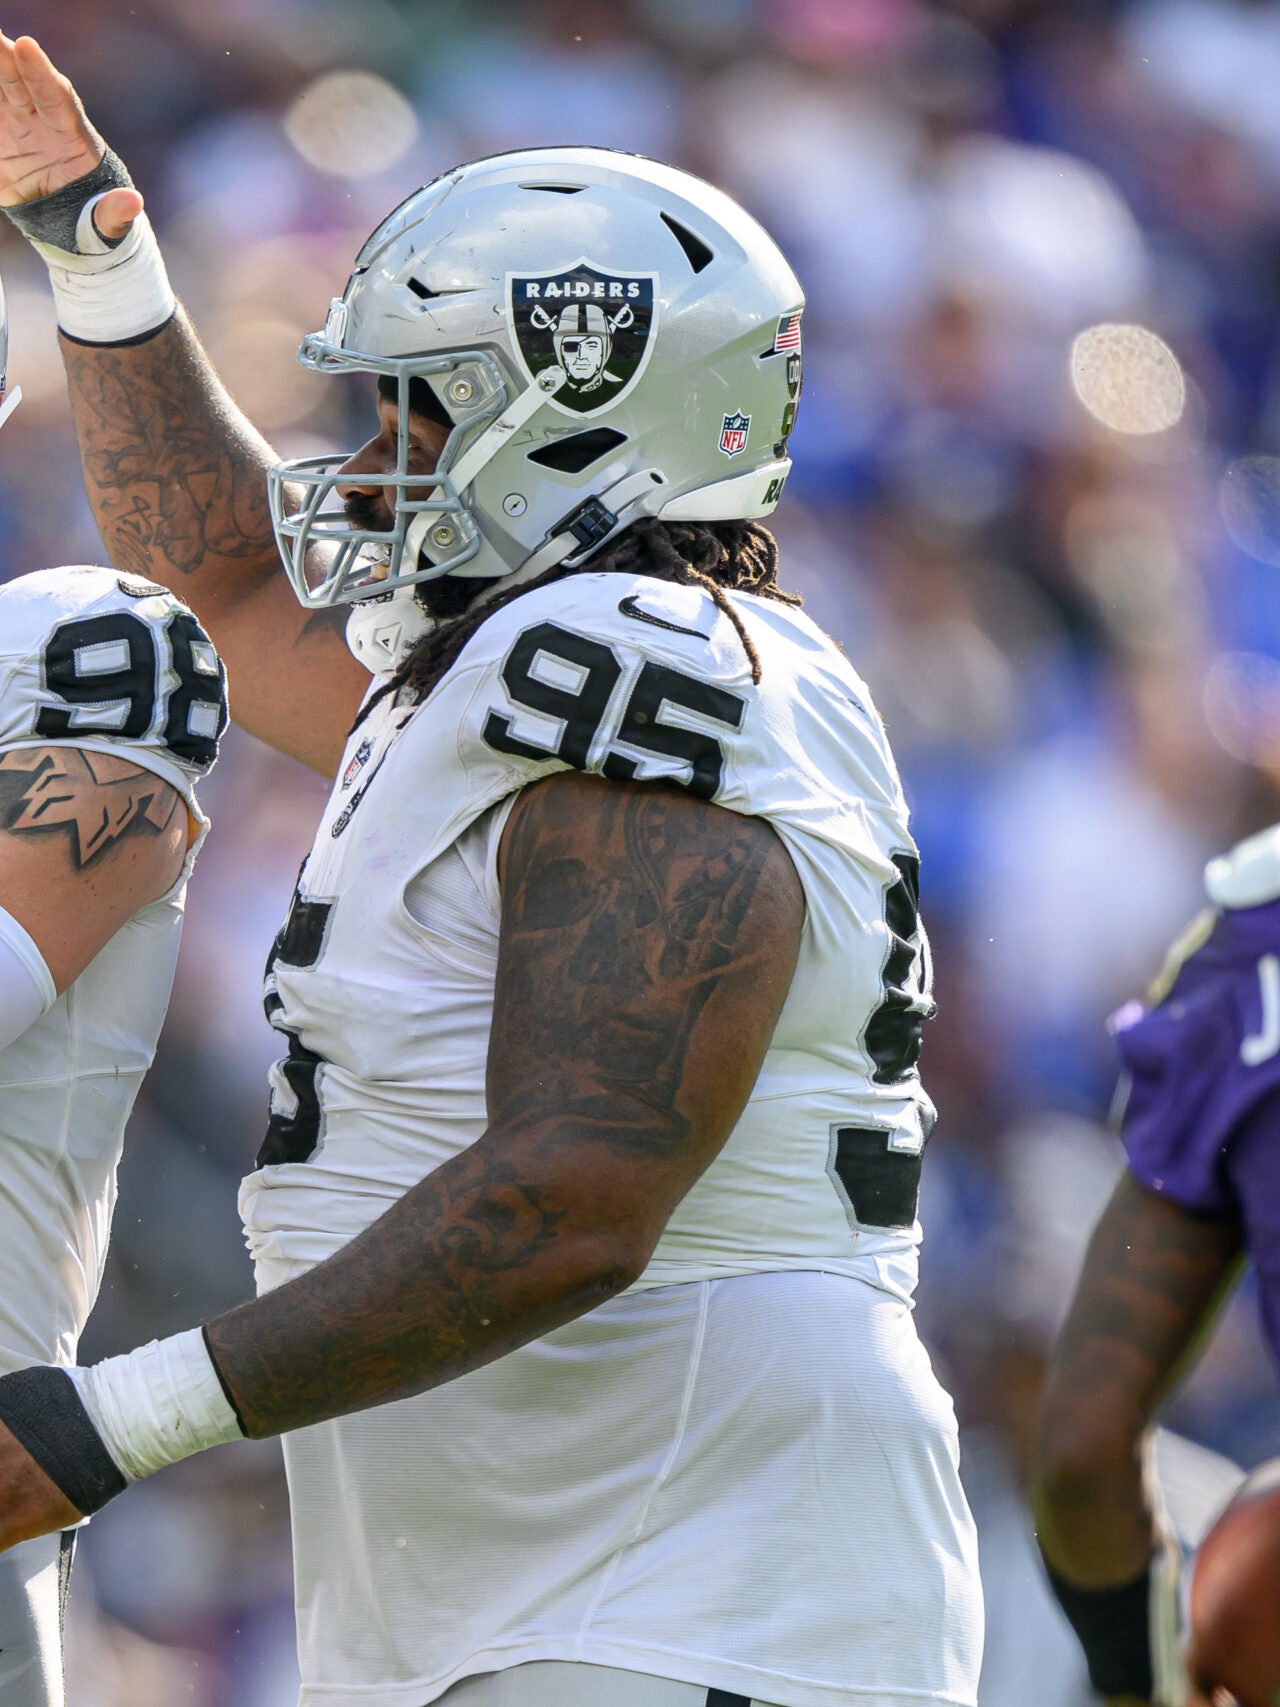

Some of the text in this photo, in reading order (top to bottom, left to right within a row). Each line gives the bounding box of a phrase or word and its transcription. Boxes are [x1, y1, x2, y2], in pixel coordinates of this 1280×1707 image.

[526, 281, 641, 298] RAIDERS
[722, 430, 744, 451] NFL
[32, 606, 230, 770] 98
[480, 618, 749, 800] 95
